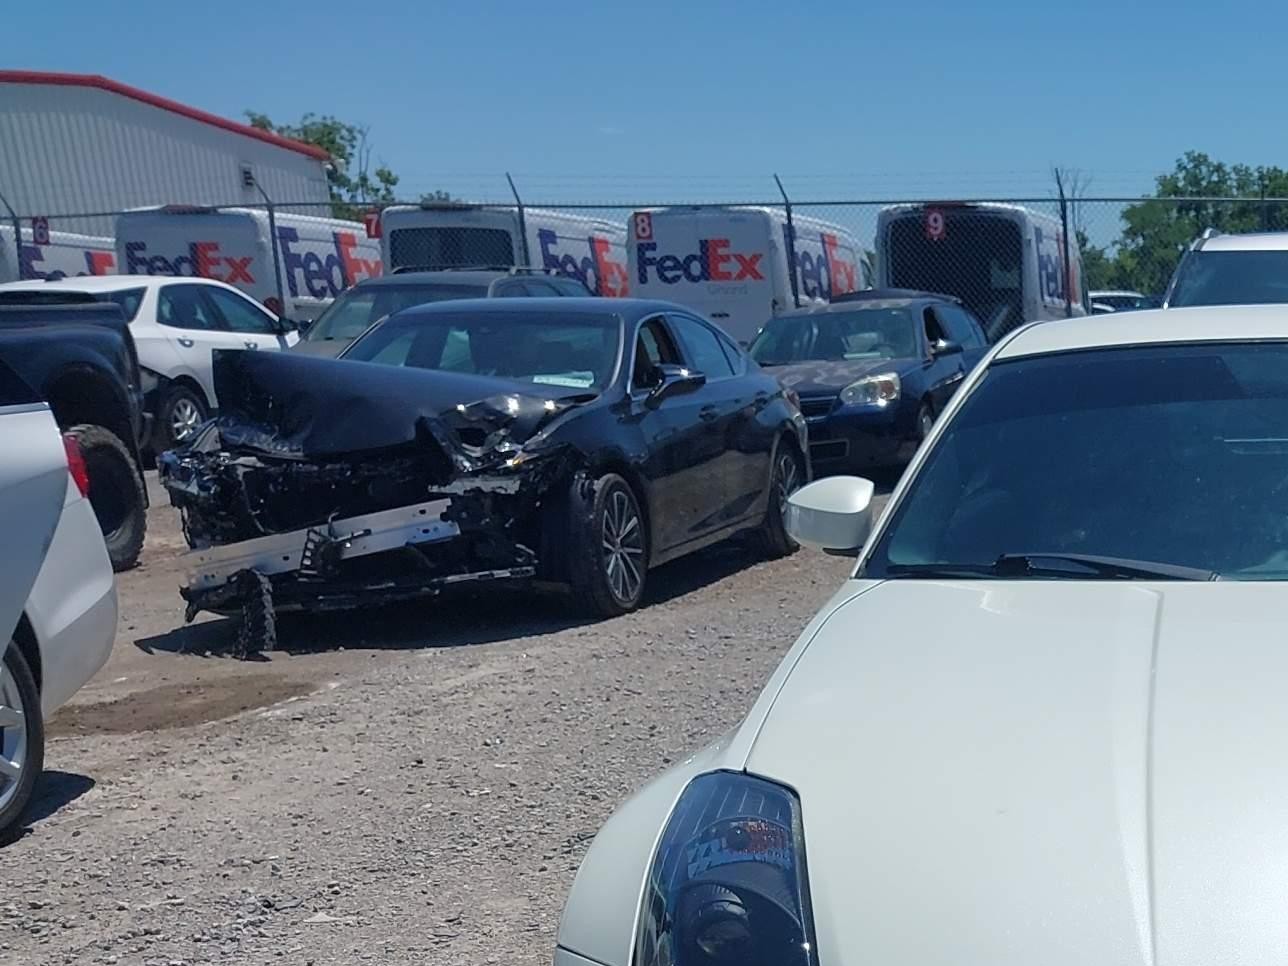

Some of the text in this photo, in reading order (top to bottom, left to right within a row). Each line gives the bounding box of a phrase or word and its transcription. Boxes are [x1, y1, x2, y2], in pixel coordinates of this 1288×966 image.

[34, 221, 48, 243] 6
[366, 213, 378, 235] 7
[637, 214, 651, 237] 8
[928, 212, 943, 235] 9
[125, 240, 256, 284] FedEx
[636, 239, 766, 285] FedEx
